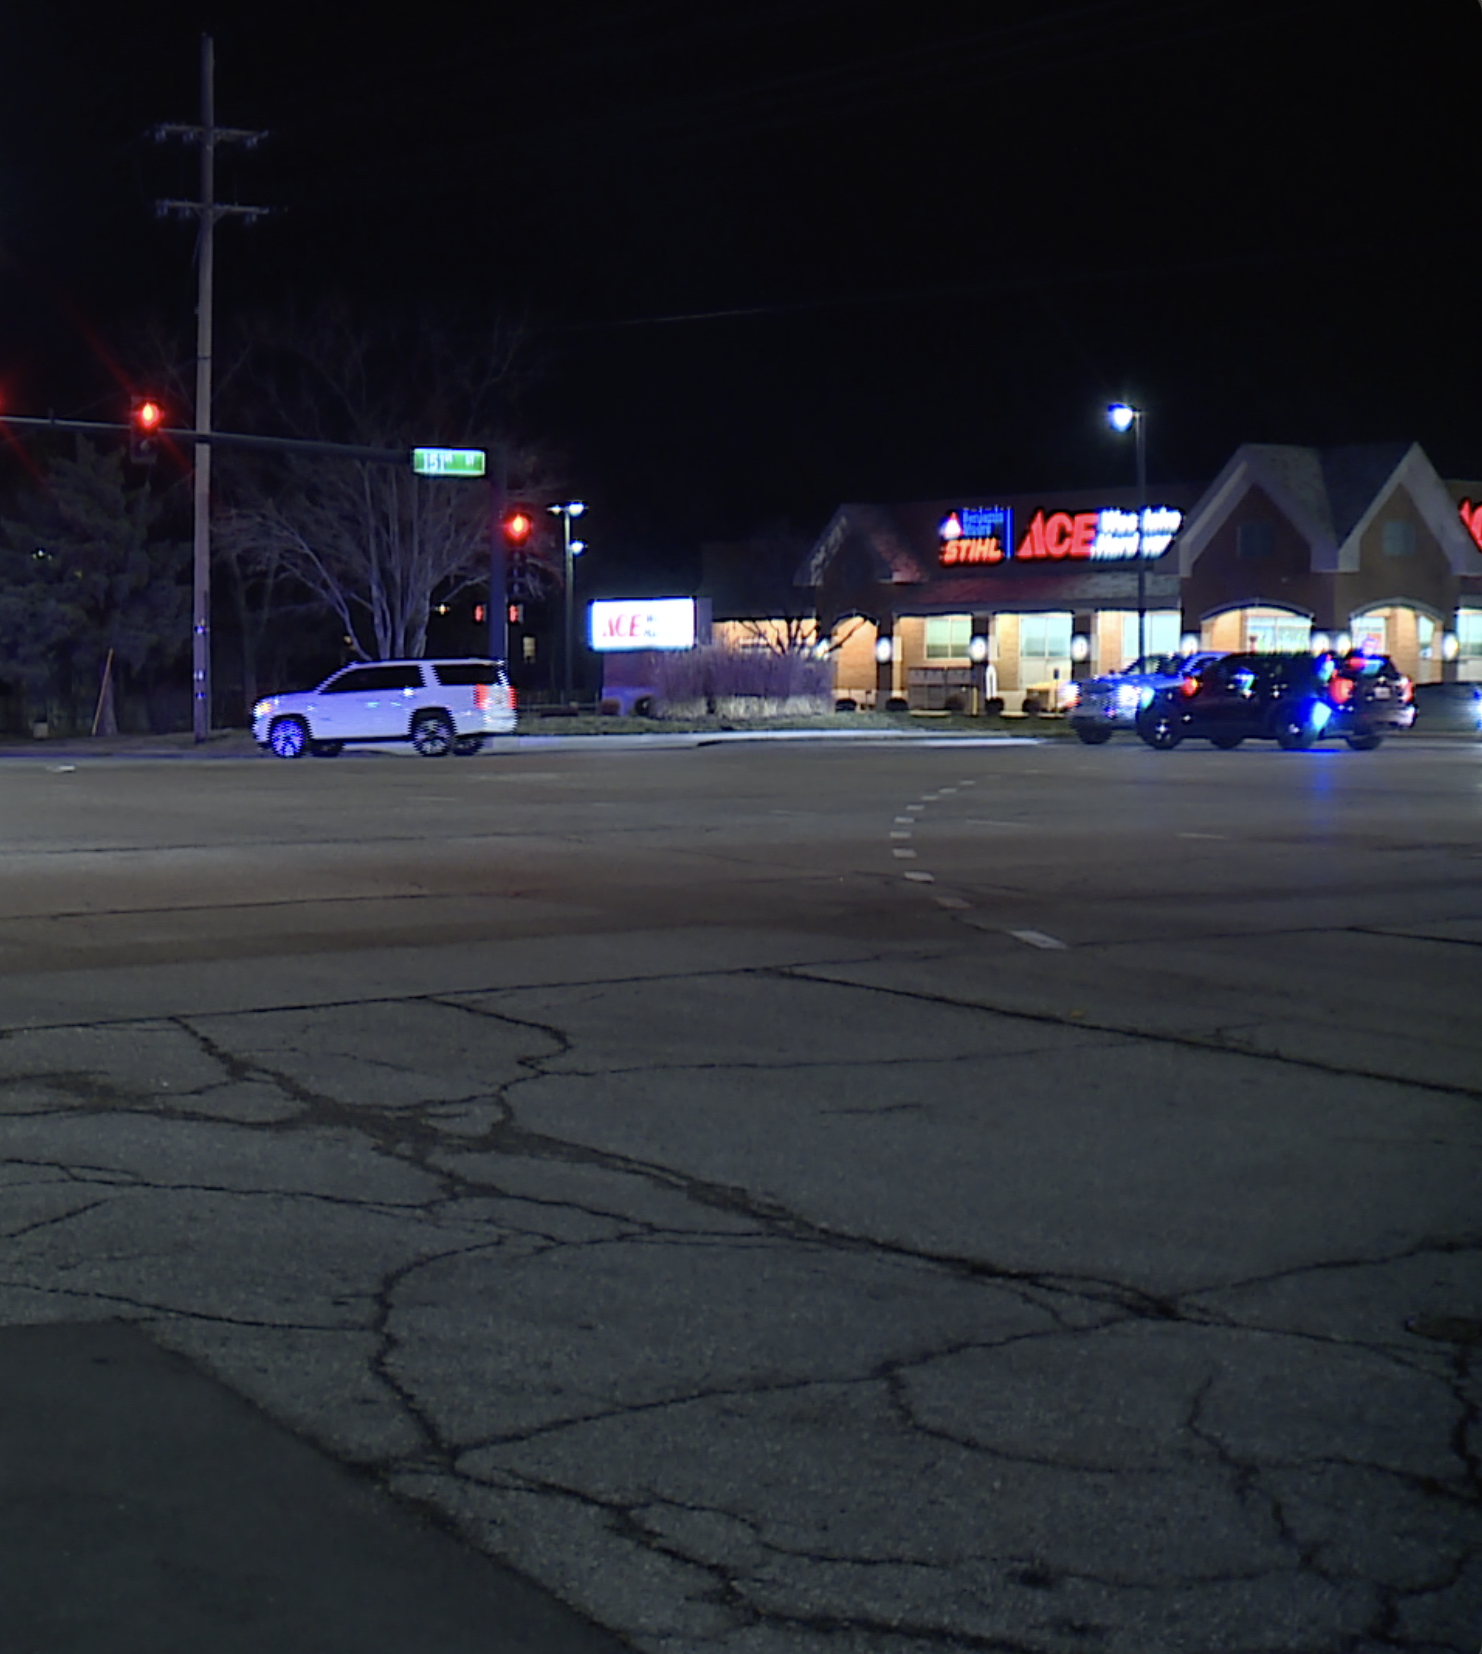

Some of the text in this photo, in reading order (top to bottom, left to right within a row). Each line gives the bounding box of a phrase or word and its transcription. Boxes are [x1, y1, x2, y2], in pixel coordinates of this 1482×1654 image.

[1018, 510, 1098, 558] ACE
[944, 537, 1002, 562] STIHL
[602, 613, 642, 637] ACE
